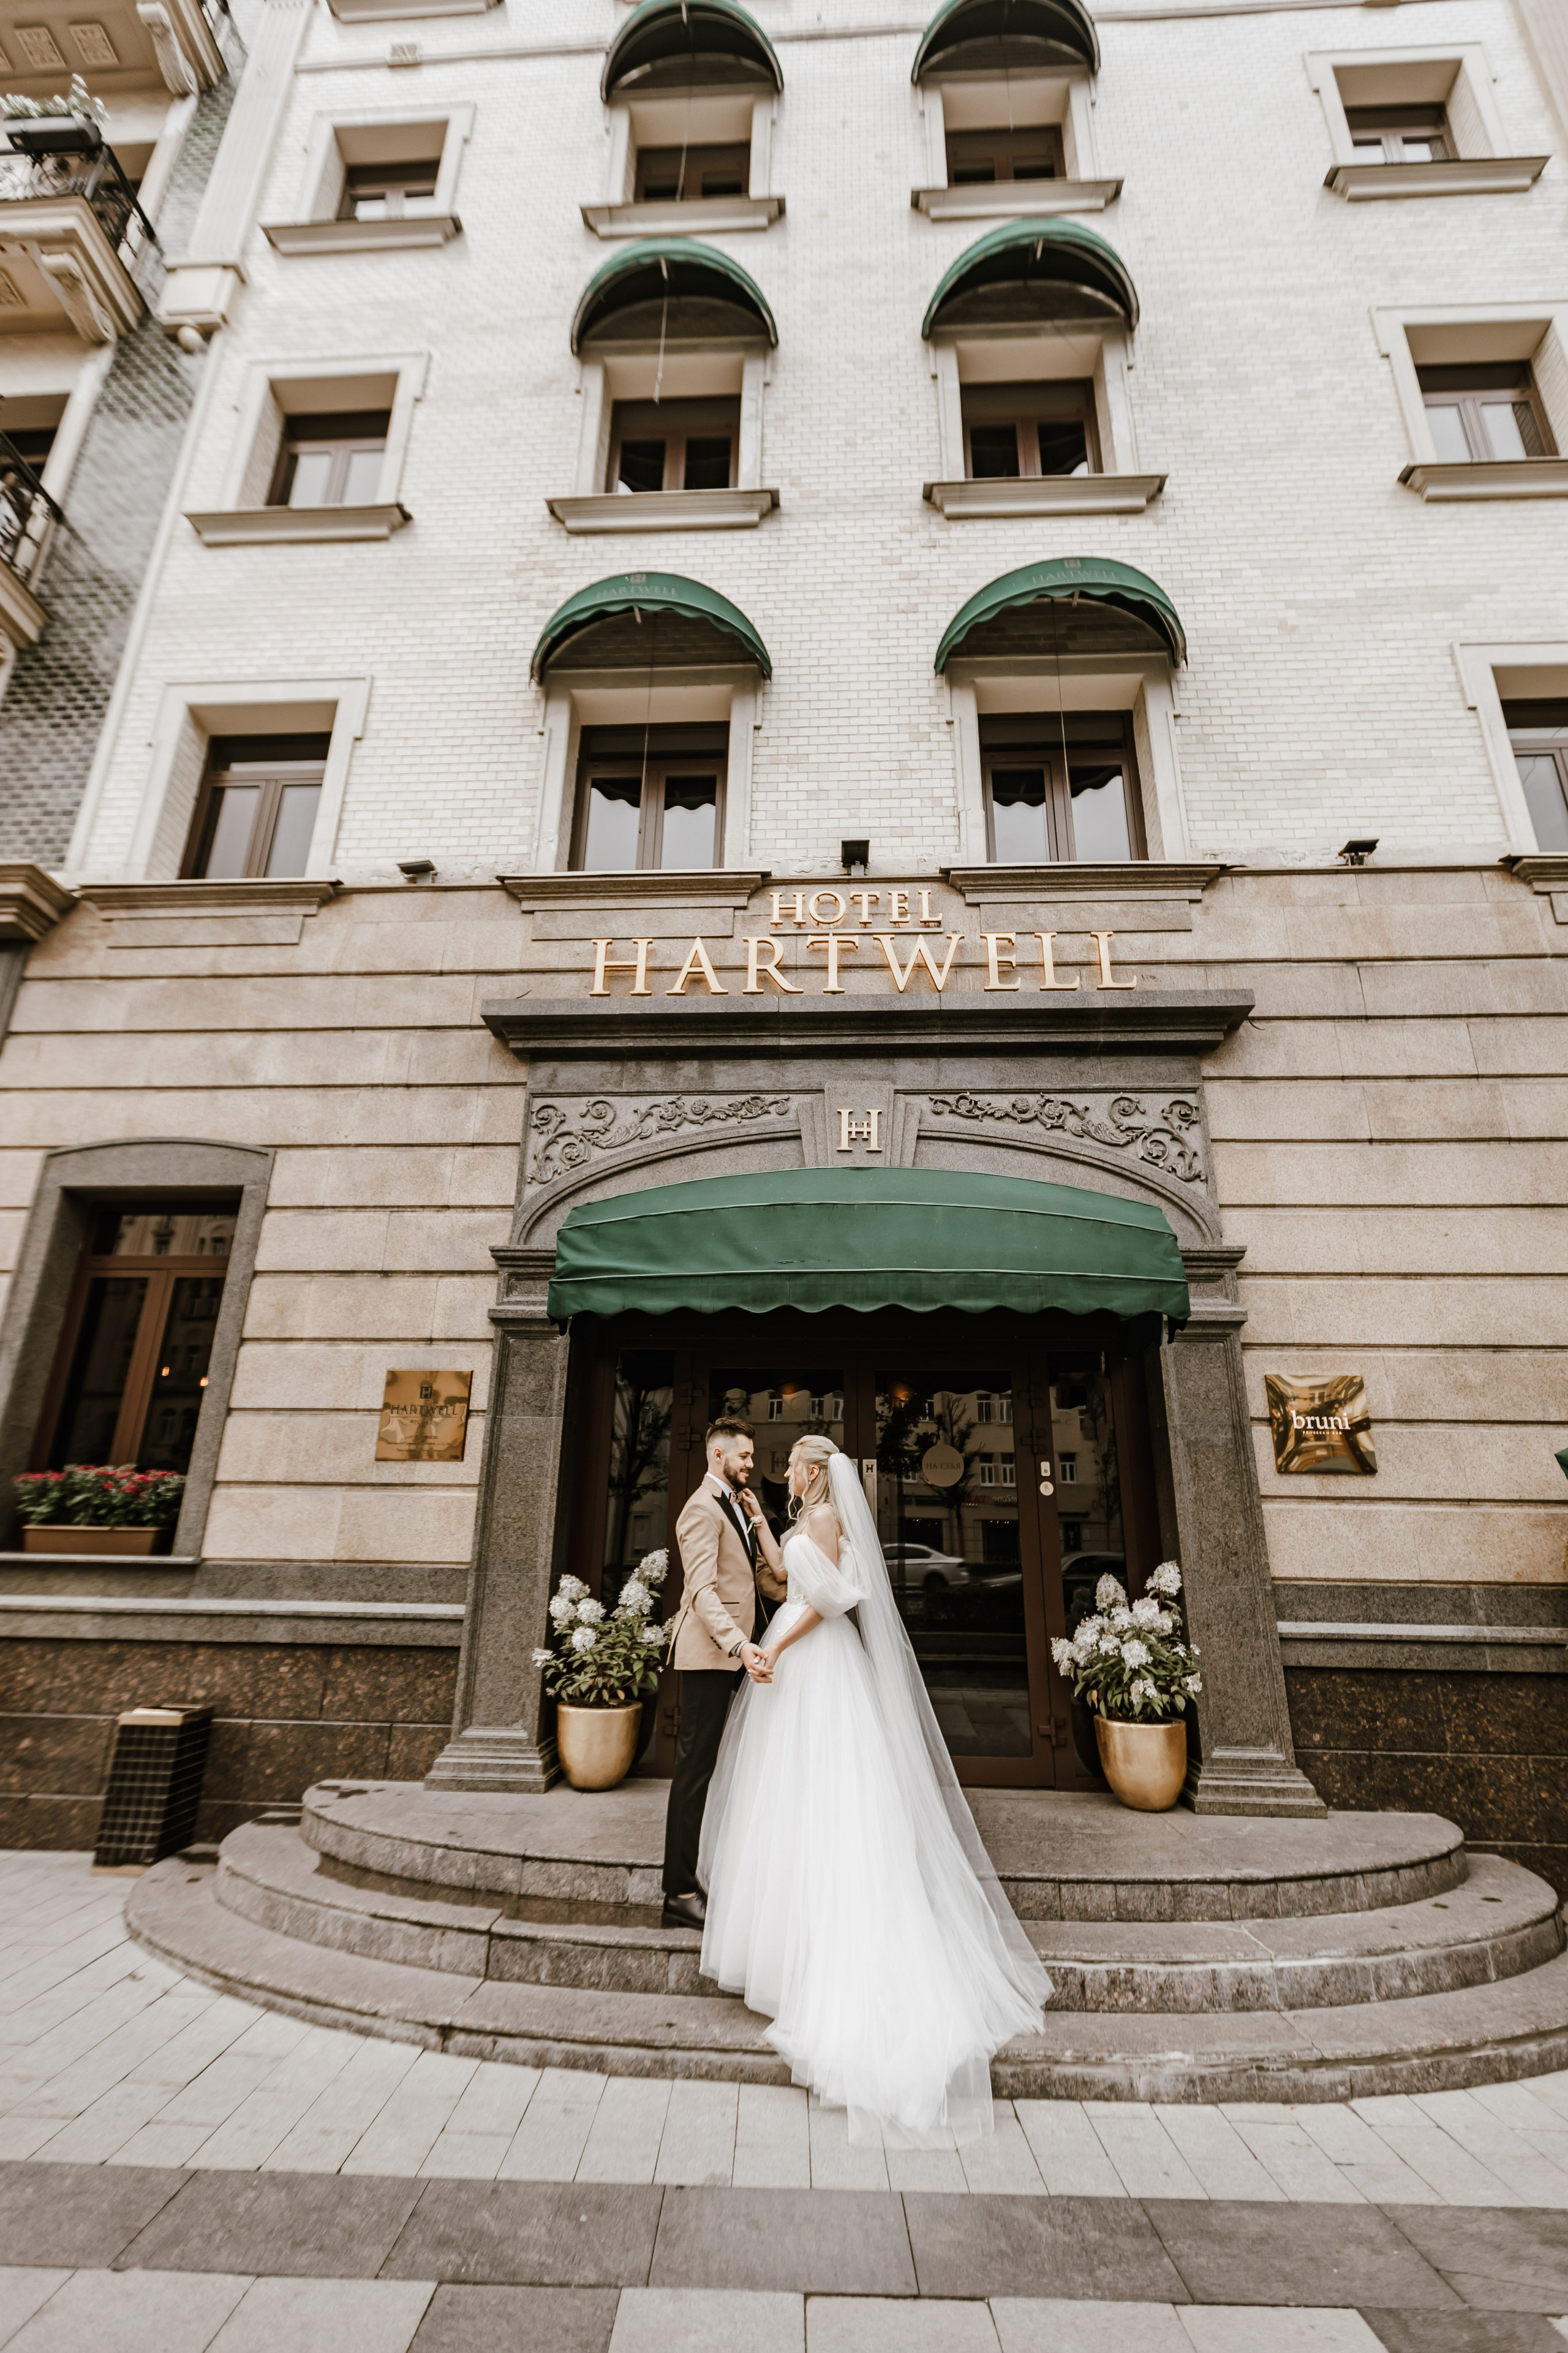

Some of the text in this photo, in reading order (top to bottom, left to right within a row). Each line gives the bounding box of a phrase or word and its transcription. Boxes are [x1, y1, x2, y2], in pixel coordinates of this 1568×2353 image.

[769, 889, 943, 926] HOTEL
[589, 931, 1137, 997] HARTWELL
[390, 1405, 458, 1416] HARTWELL
[1290, 1410, 1351, 1430] bruni
